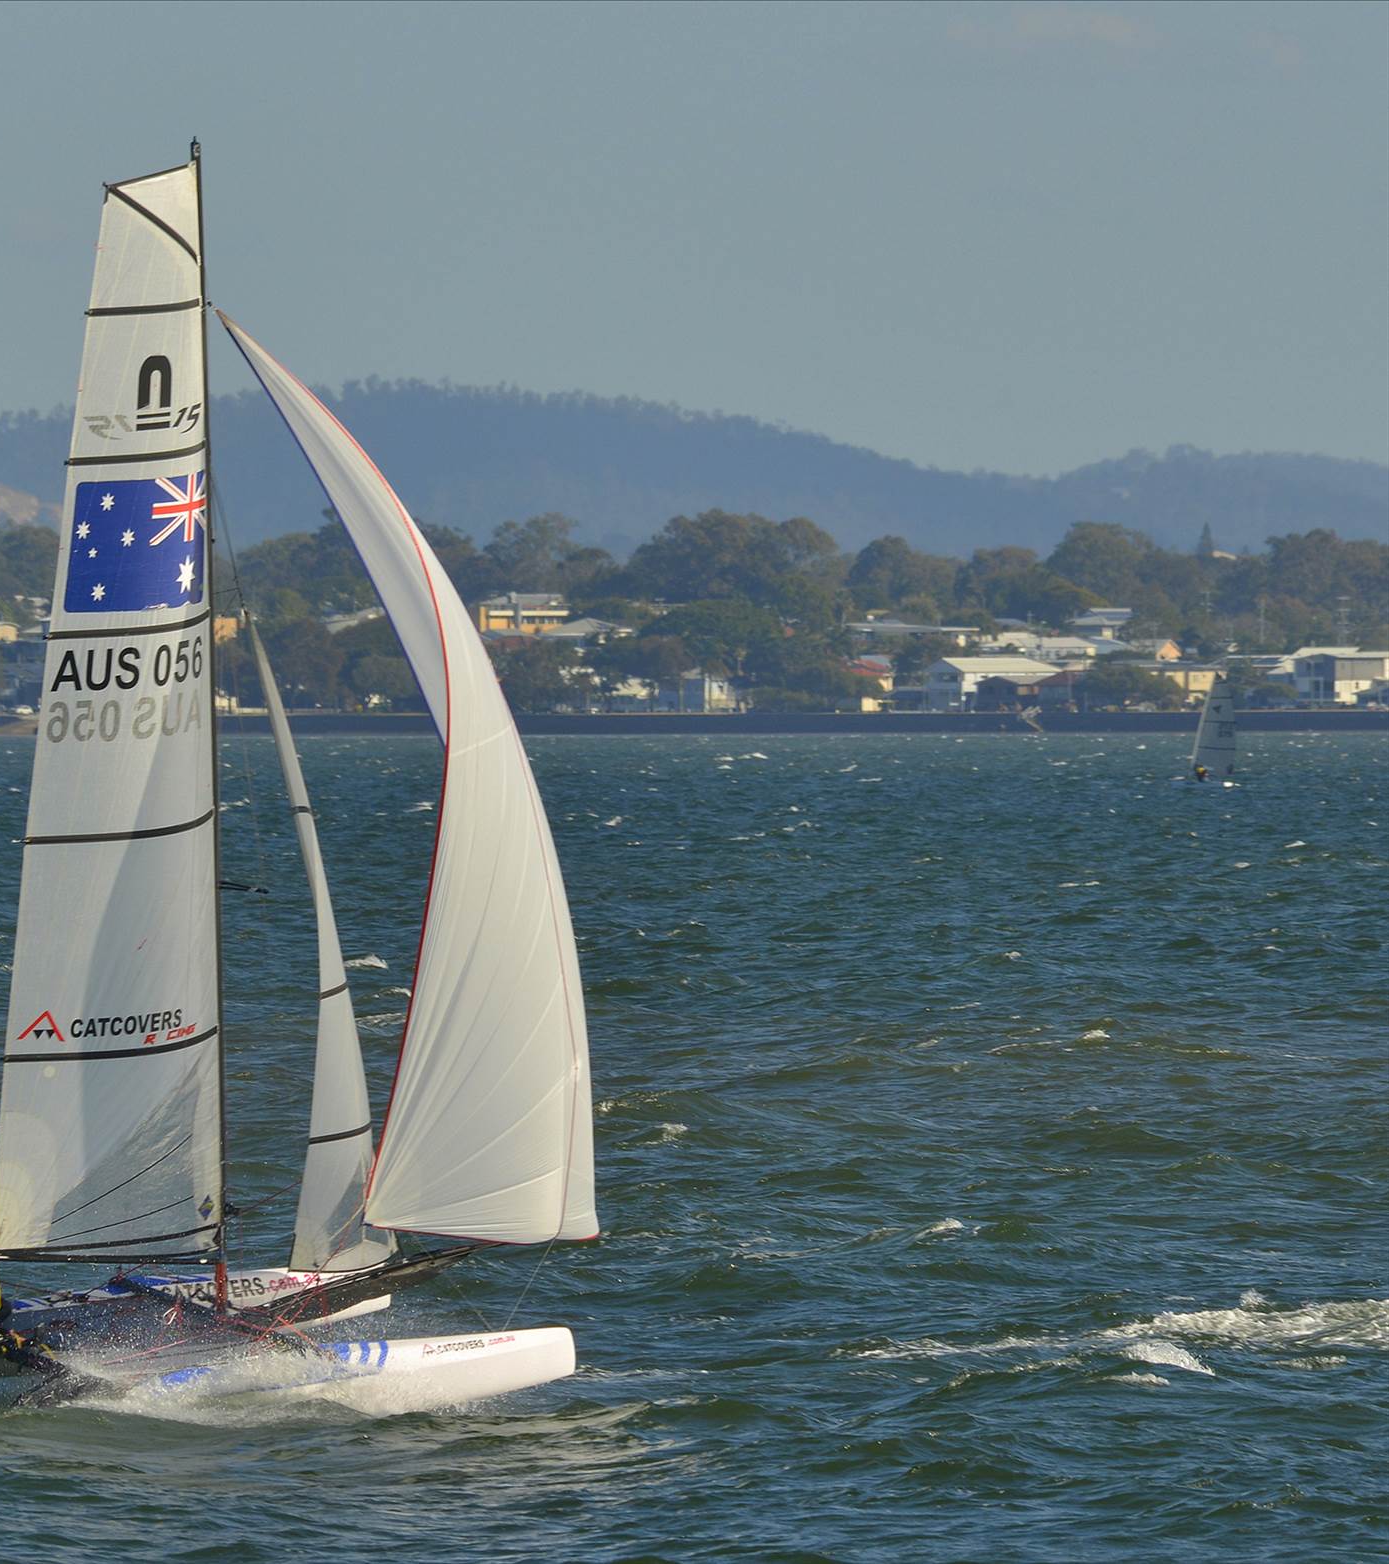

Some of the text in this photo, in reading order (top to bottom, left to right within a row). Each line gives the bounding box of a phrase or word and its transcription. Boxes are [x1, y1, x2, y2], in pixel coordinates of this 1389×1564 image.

[51, 636, 202, 692] AUS 056
[71, 1008, 182, 1038] CATCOVERS
